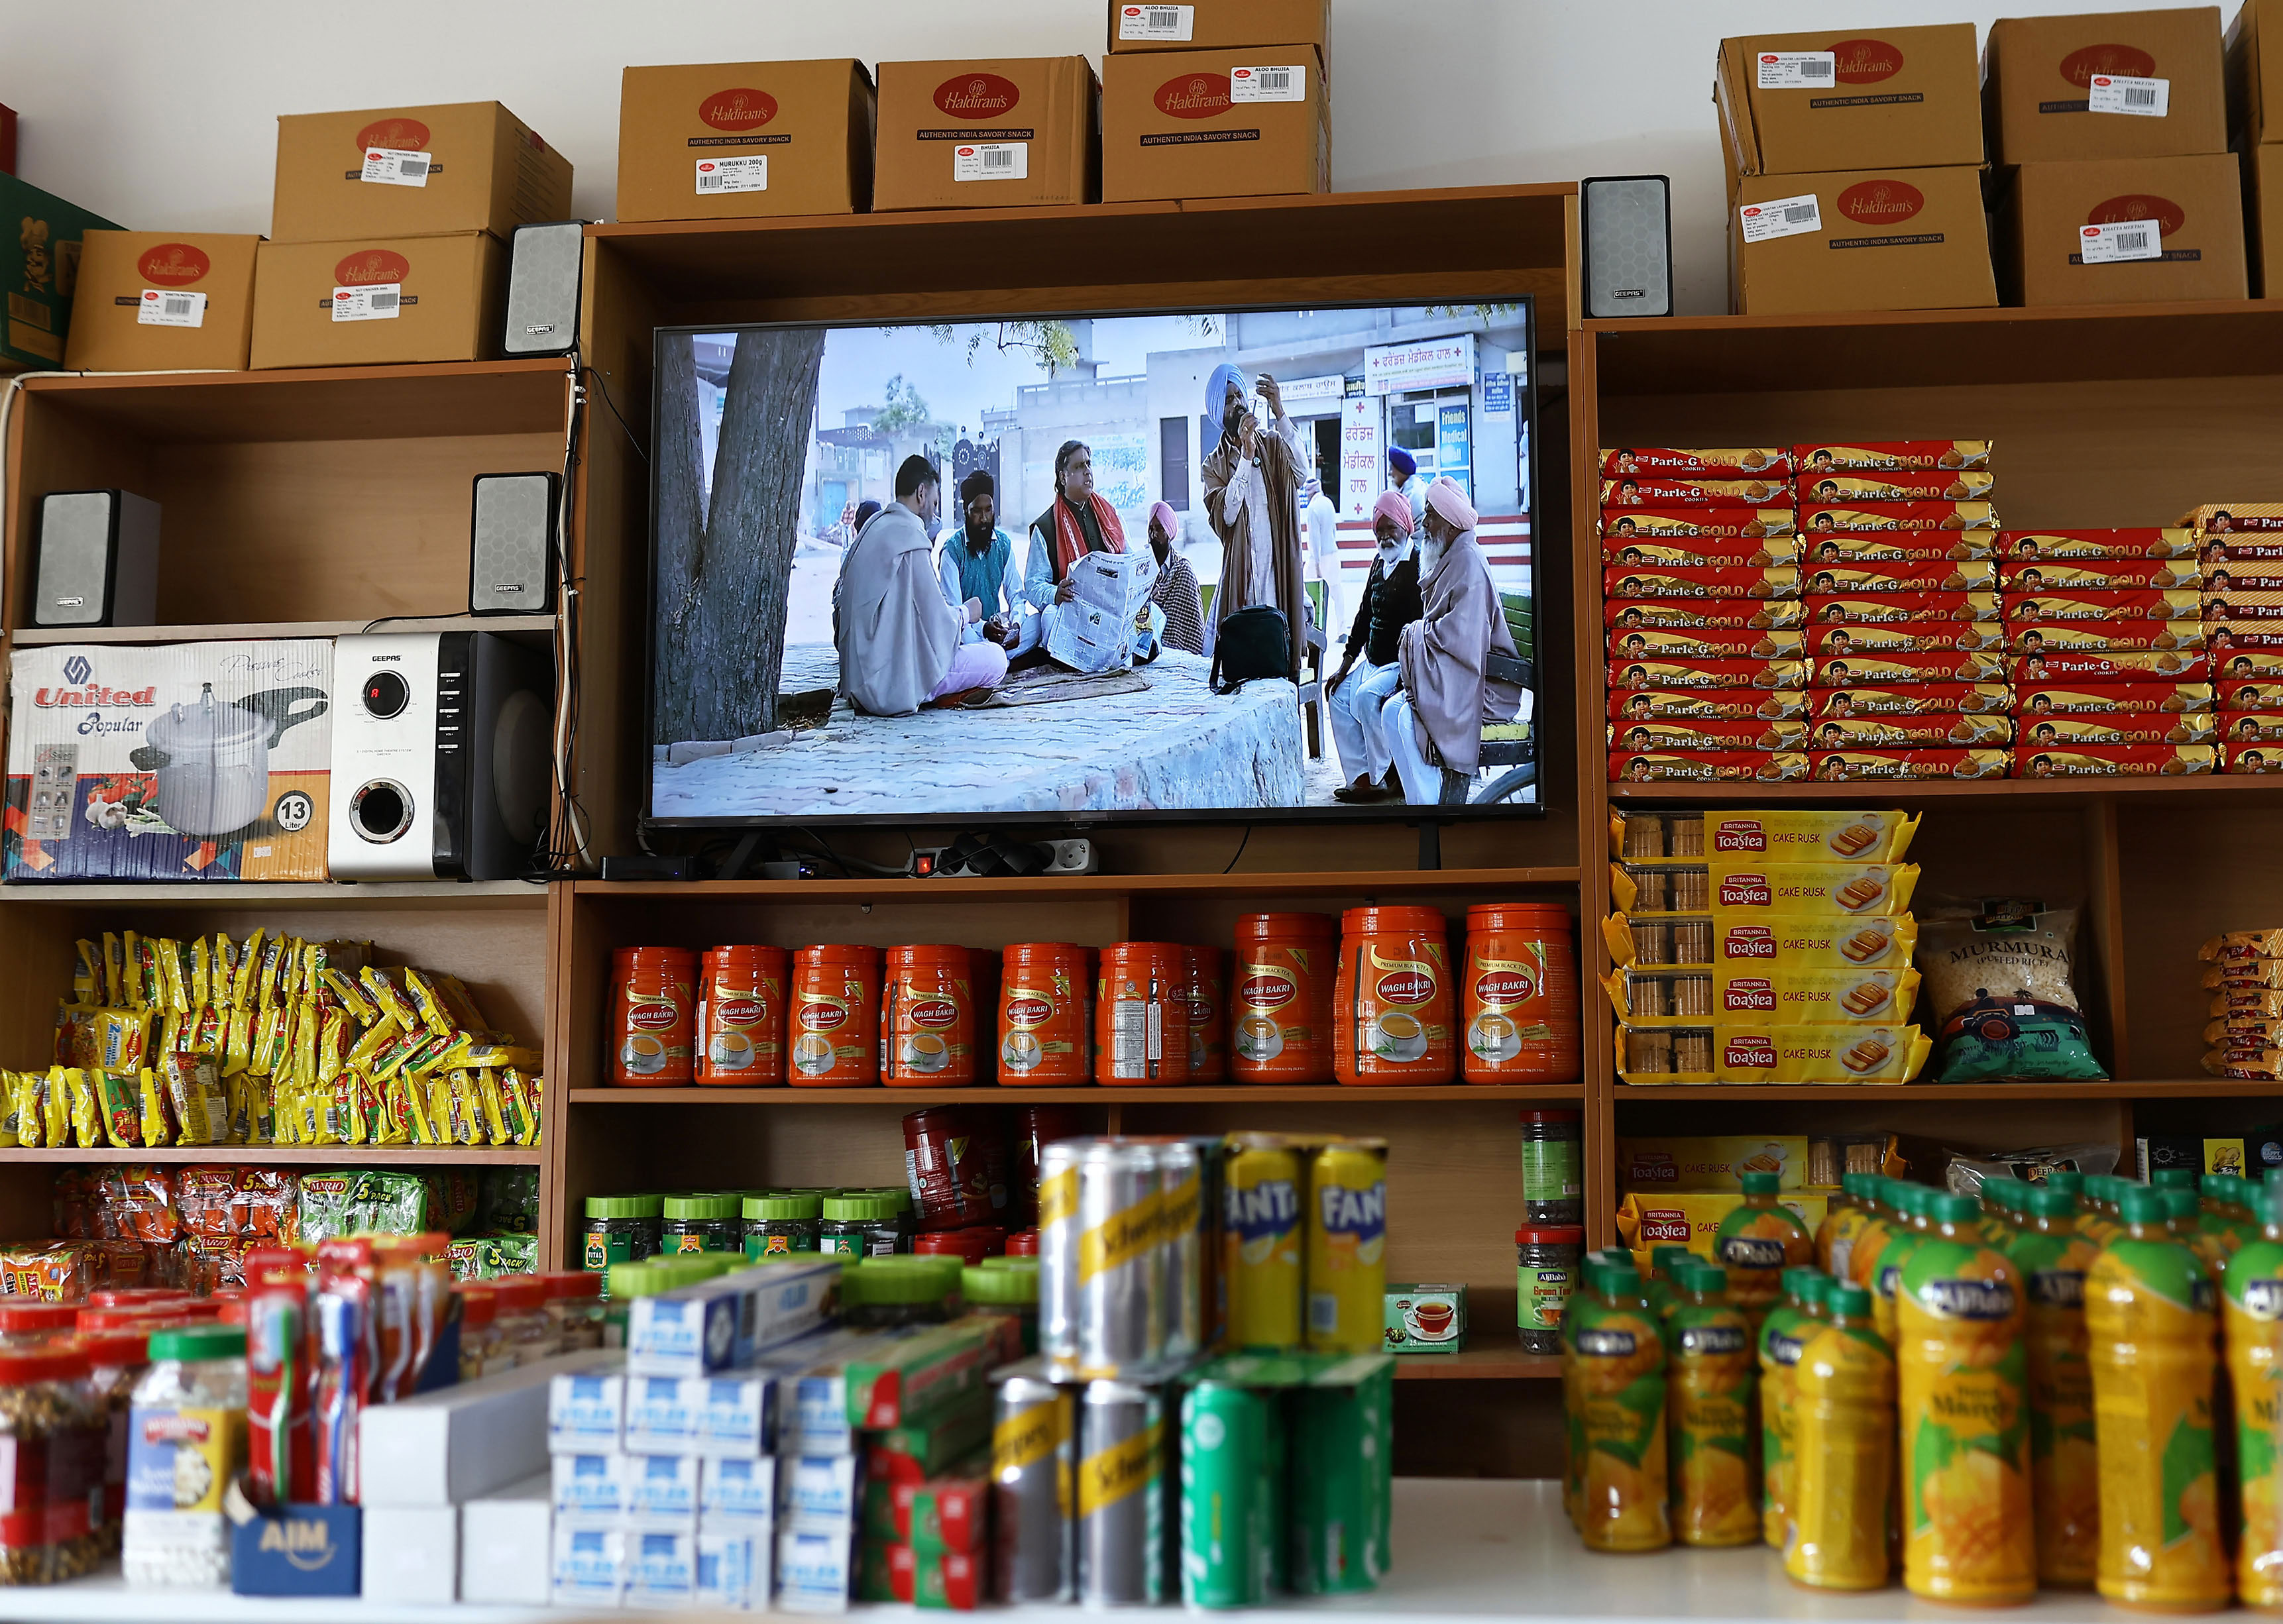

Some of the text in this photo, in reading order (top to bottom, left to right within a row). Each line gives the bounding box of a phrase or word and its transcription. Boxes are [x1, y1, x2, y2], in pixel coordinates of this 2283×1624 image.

[944, 91, 1008, 109] Haldiram's
[1165, 92, 1229, 111] Haldiram's
[710, 105, 768, 121] Haldiram's
[1142, 136, 1182, 144] AUTHENTIC
[1203, 133, 1233, 141] SAVORY
[1850, 197, 1914, 215] Haldiram's
[1831, 238, 1869, 248] AUTHENTIC
[1650, 455, 1738, 466] Parle-G GOLD
[1848, 455, 1934, 468] Parle-G GOLD
[1350, 478, 1367, 493] ਹਾਲ
[2061, 658, 2151, 671] Parle-G GOLD
[34, 682, 156, 706] United
[77, 712, 144, 737] Popular
[280, 801, 306, 820] 13
[1772, 833, 1820, 844] CAKE RUSK
[1777, 887, 1826, 898] CAKE RUSK
[1783, 939, 1830, 950] CAKE RUSK
[1948, 940, 2069, 964] MURMURA
[1976, 956, 2048, 967] (PUFFED RICE)
[1243, 984, 1290, 996] WAGH BAKRI
[1380, 983, 1406, 994] WAGH
[1478, 980, 1528, 993] WAGH BAKRI
[1783, 991, 1831, 1002] CAKE RUSK
[631, 1010, 674, 1020] WAGH BAKRI
[720, 1006, 761, 1016] WAGH BAKRI
[801, 1010, 842, 1020] WAGH BAKRI
[913, 1008, 956, 1018] WAGH BAKRI
[1027, 1005, 1048, 1014] BAKRI
[1783, 1048, 1832, 1059] CAKE RUSK
[1685, 1164, 1730, 1173] CAKE RUSK
[199, 1173, 230, 1184] MARIO
[243, 1174, 254, 1190] 5
[310, 1180, 345, 1192] MARIO
[357, 1183, 370, 1201] 5
[1697, 1222, 1719, 1233] CAKE
[239, 1240, 254, 1256] 5
[488, 1248, 502, 1266] 5
[1533, 1285, 1557, 1295] Green
[258, 1521, 329, 1554] AIM
